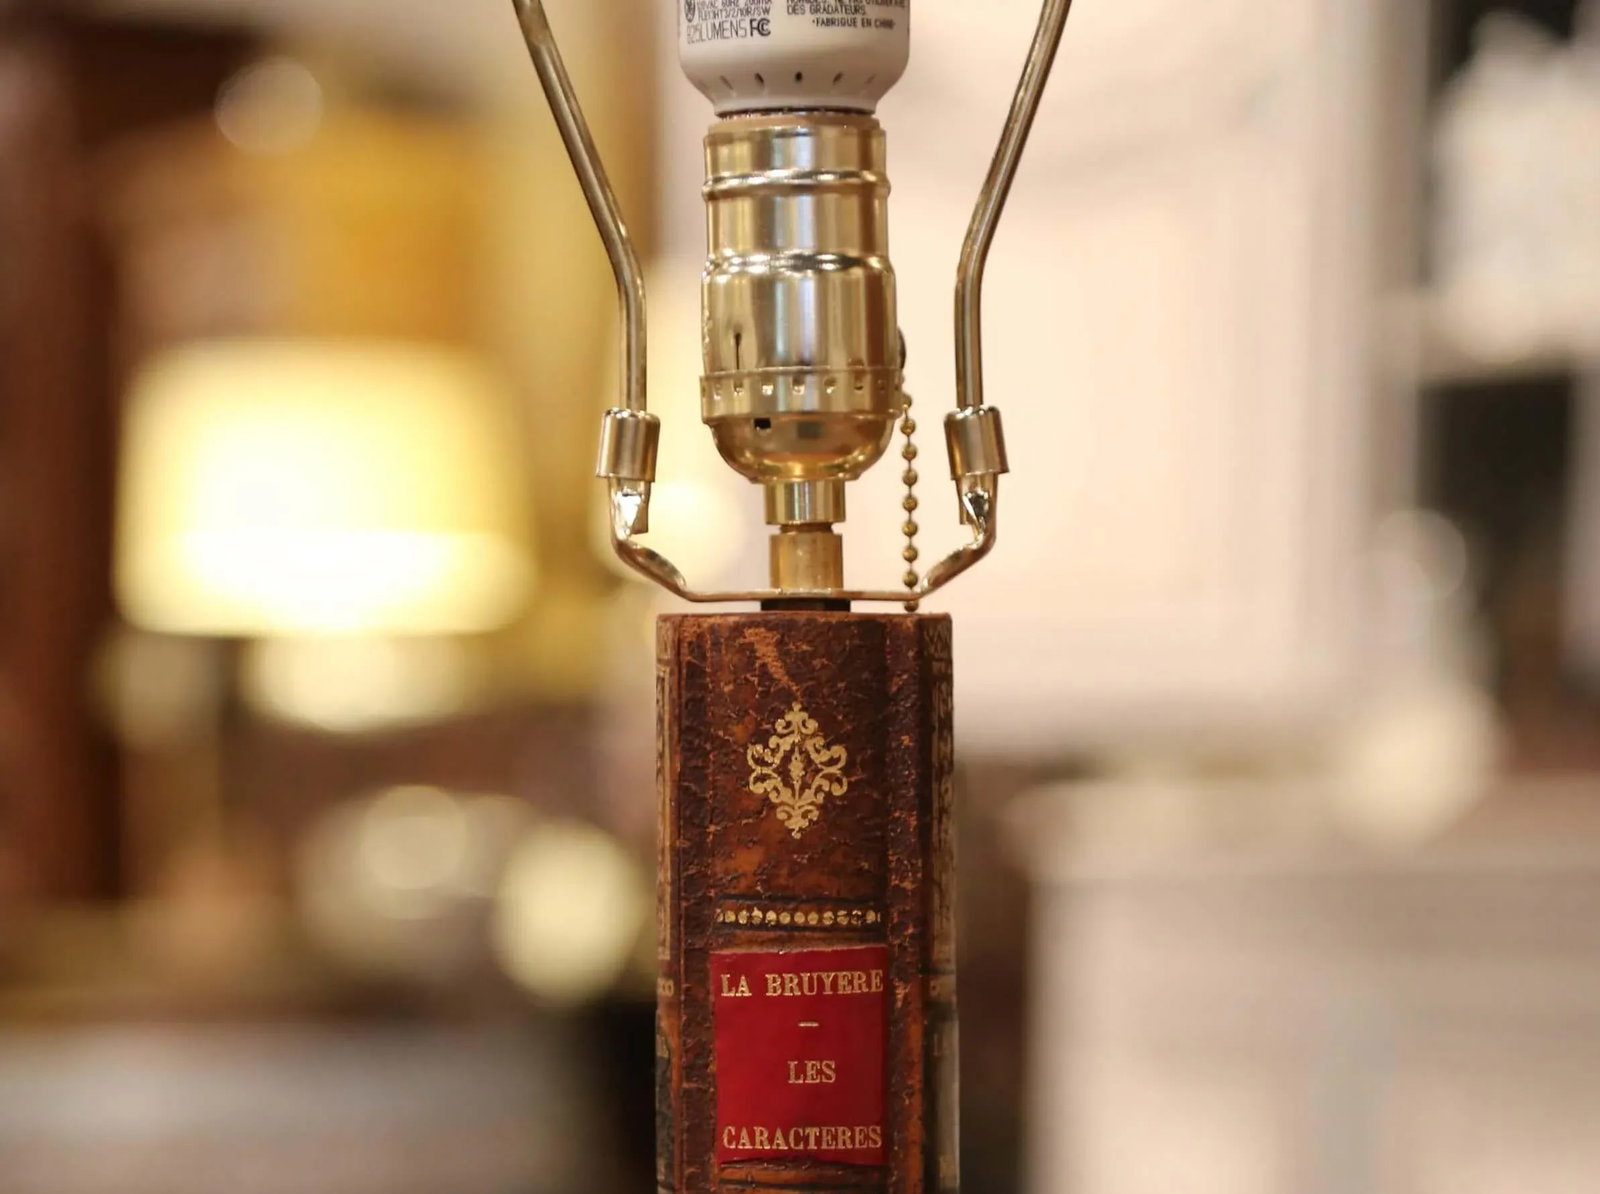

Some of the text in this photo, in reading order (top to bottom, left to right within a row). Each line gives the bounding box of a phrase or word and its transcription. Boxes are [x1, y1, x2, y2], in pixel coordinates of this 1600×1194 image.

[787, 5, 806, 15] DES
[861, 18, 871, 27] EN
[720, 969, 883, 997] LA BRUYERE
[787, 1060, 836, 1084] LES
[722, 1125, 882, 1150] CARACTERES
